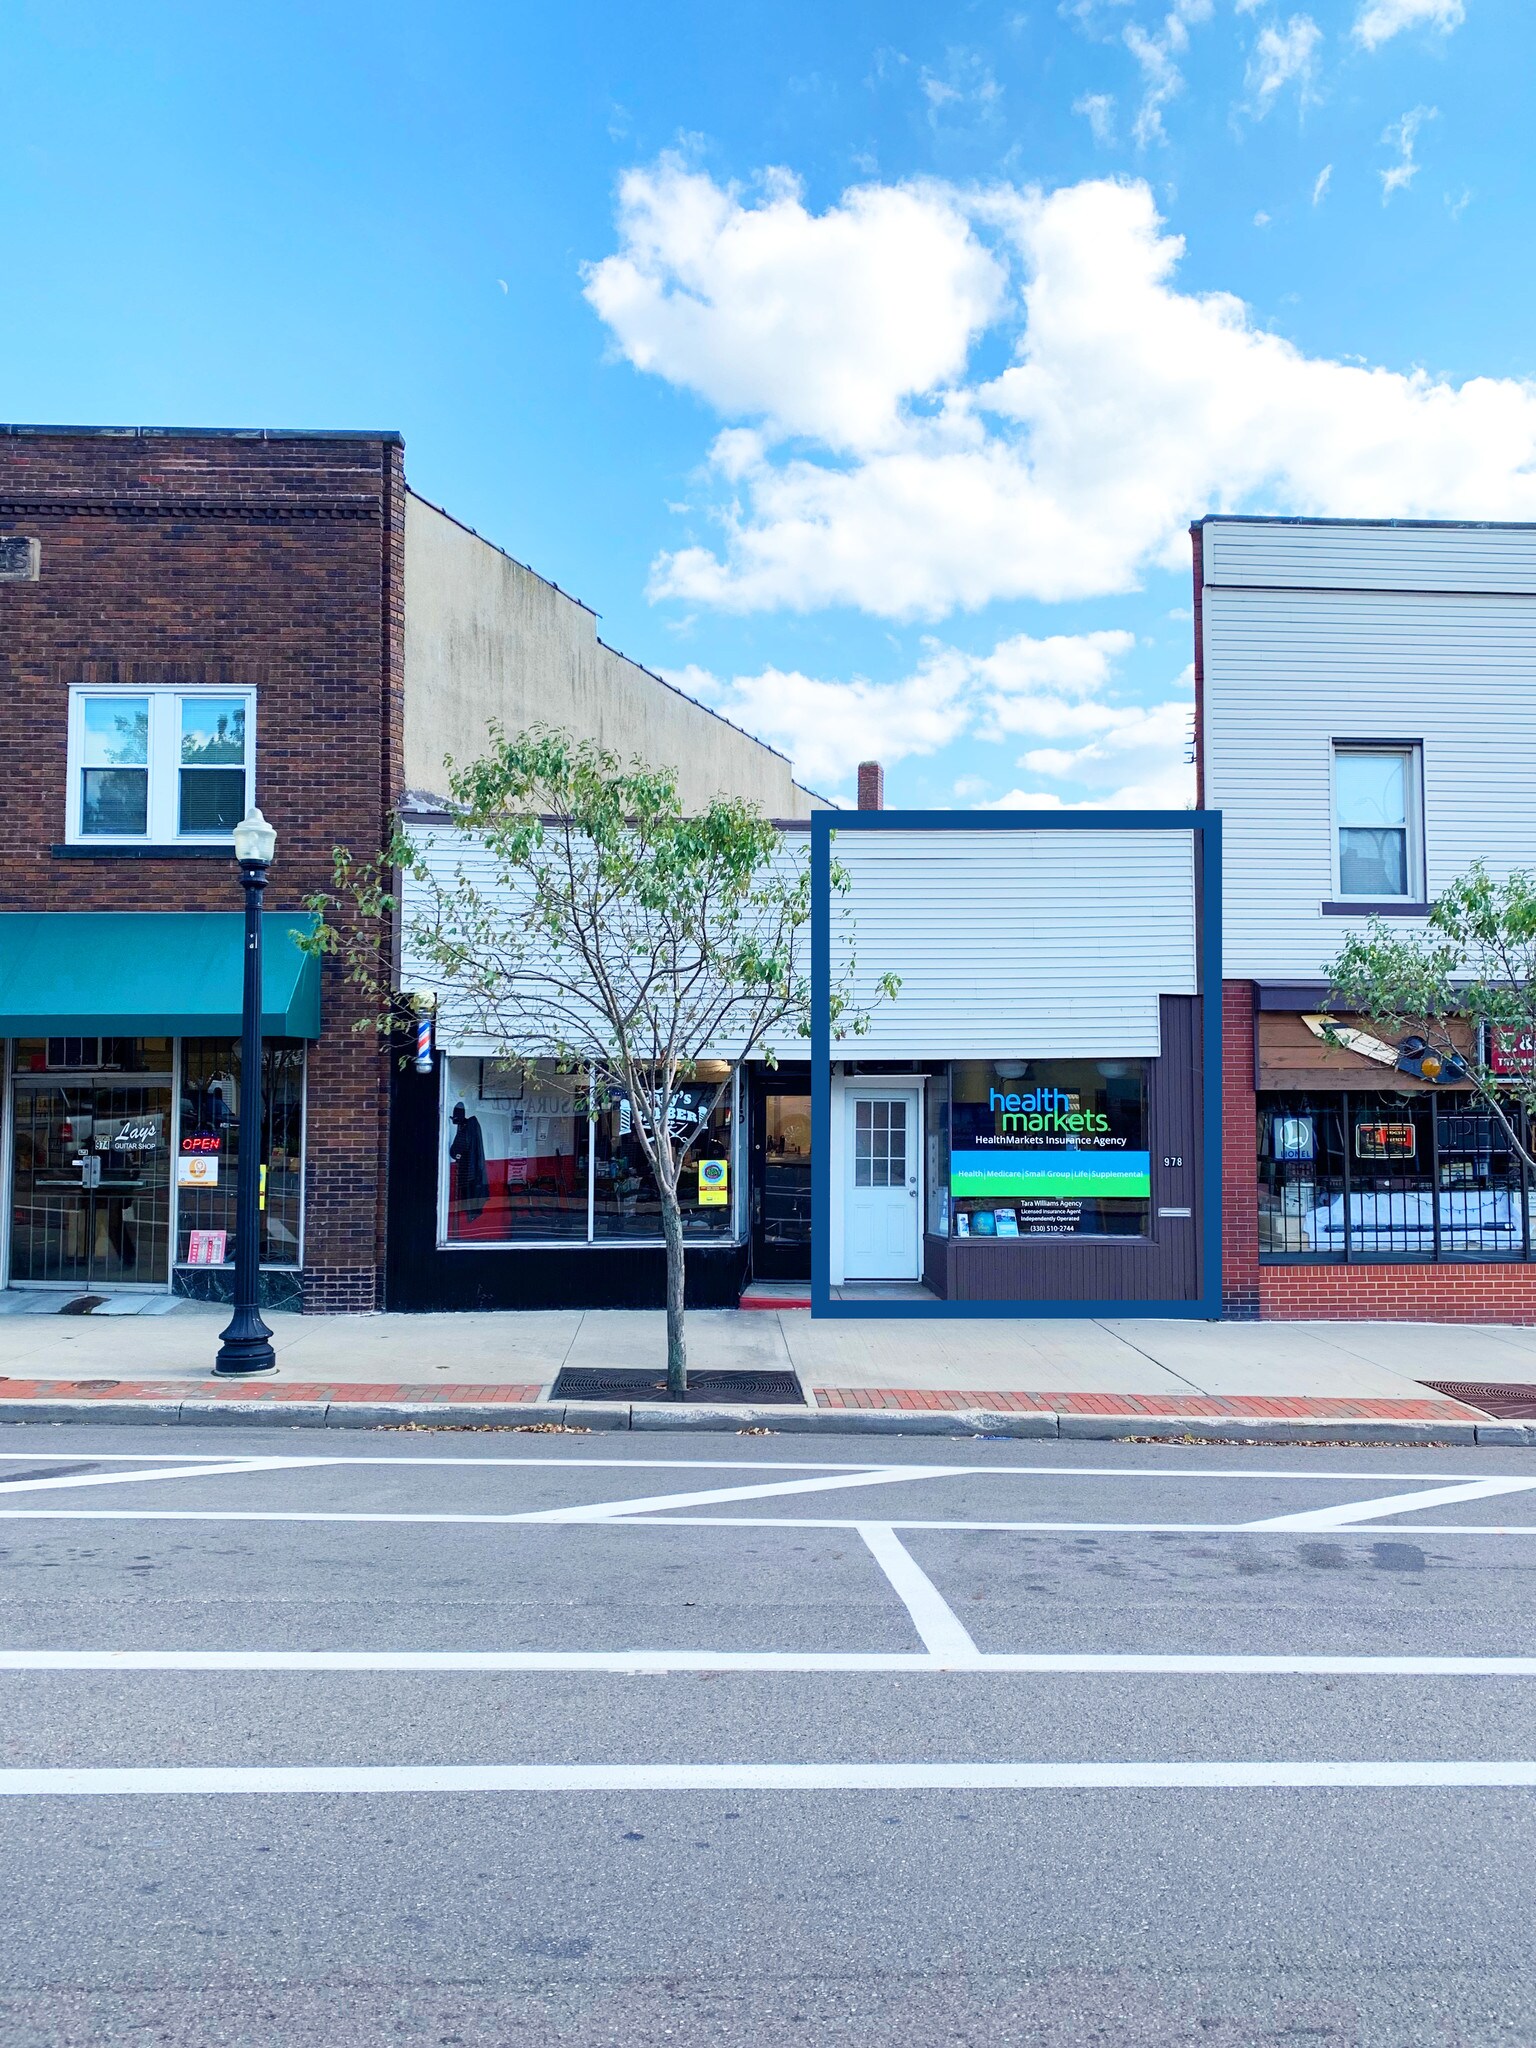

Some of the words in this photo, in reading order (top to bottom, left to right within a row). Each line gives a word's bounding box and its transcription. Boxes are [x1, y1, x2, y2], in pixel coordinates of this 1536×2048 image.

[989, 1087, 1069, 1112] health
[114, 1121, 157, 1143] Lay's
[1437, 1120, 1511, 1148] OPEN
[95, 1140, 109, 1150] 974
[183, 1138, 220, 1150] OPEN
[975, 1135, 1044, 1145] HealthMarkets
[1045, 1136, 1091, 1145] Insurance
[1093, 1136, 1127, 1147] Agency
[1280, 1150, 1310, 1158] LIONEL
[1163, 1157, 1183, 1167] 978
[958, 1170, 983, 1178] Health
[986, 1170, 1022, 1178] Medicare
[1024, 1170, 1046, 1178] Small
[1047, 1171, 1071, 1179] Group
[1091, 1171, 1143, 1179] Supplemental
[1059, 1200, 1083, 1208] Agency
[1030, 1225, 1046, 1233] (330)
